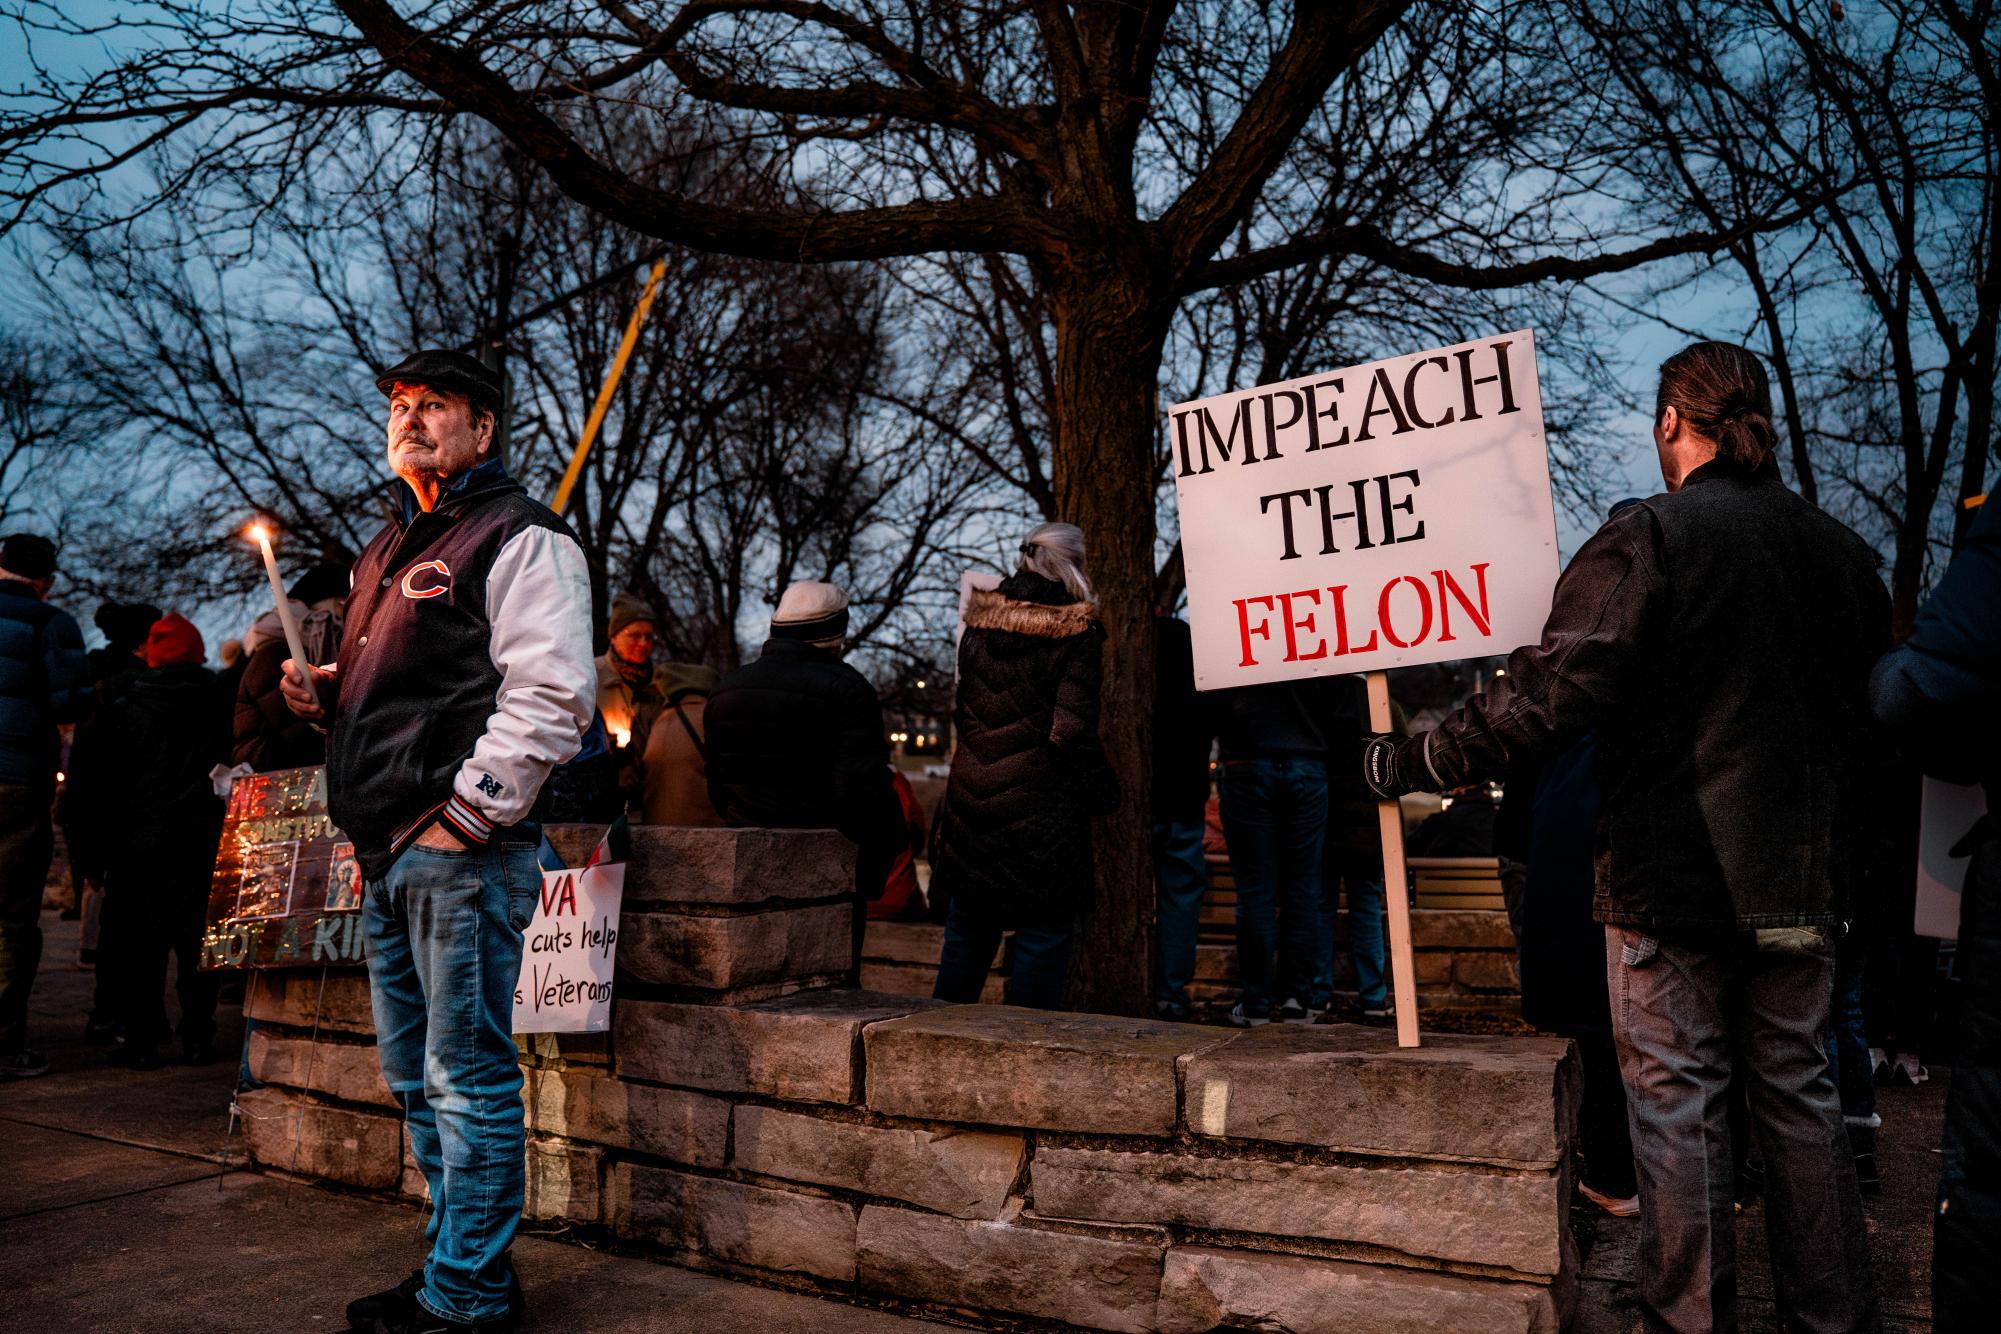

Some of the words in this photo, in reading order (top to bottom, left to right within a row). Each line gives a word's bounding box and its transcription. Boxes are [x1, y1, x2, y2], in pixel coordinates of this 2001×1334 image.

[1171, 341, 1521, 478] IMPEACH
[1260, 468, 1426, 561] THE
[401, 559, 451, 599] C
[1232, 563, 1492, 668] FELON
[227, 776, 270, 819] WE
[541, 873, 577, 918] VA
[201, 922, 266, 967] NOT
[275, 919, 301, 961] A
[531, 921, 572, 954] cuts
[581, 915, 617, 959] help
[533, 962, 613, 1014] Veterans
